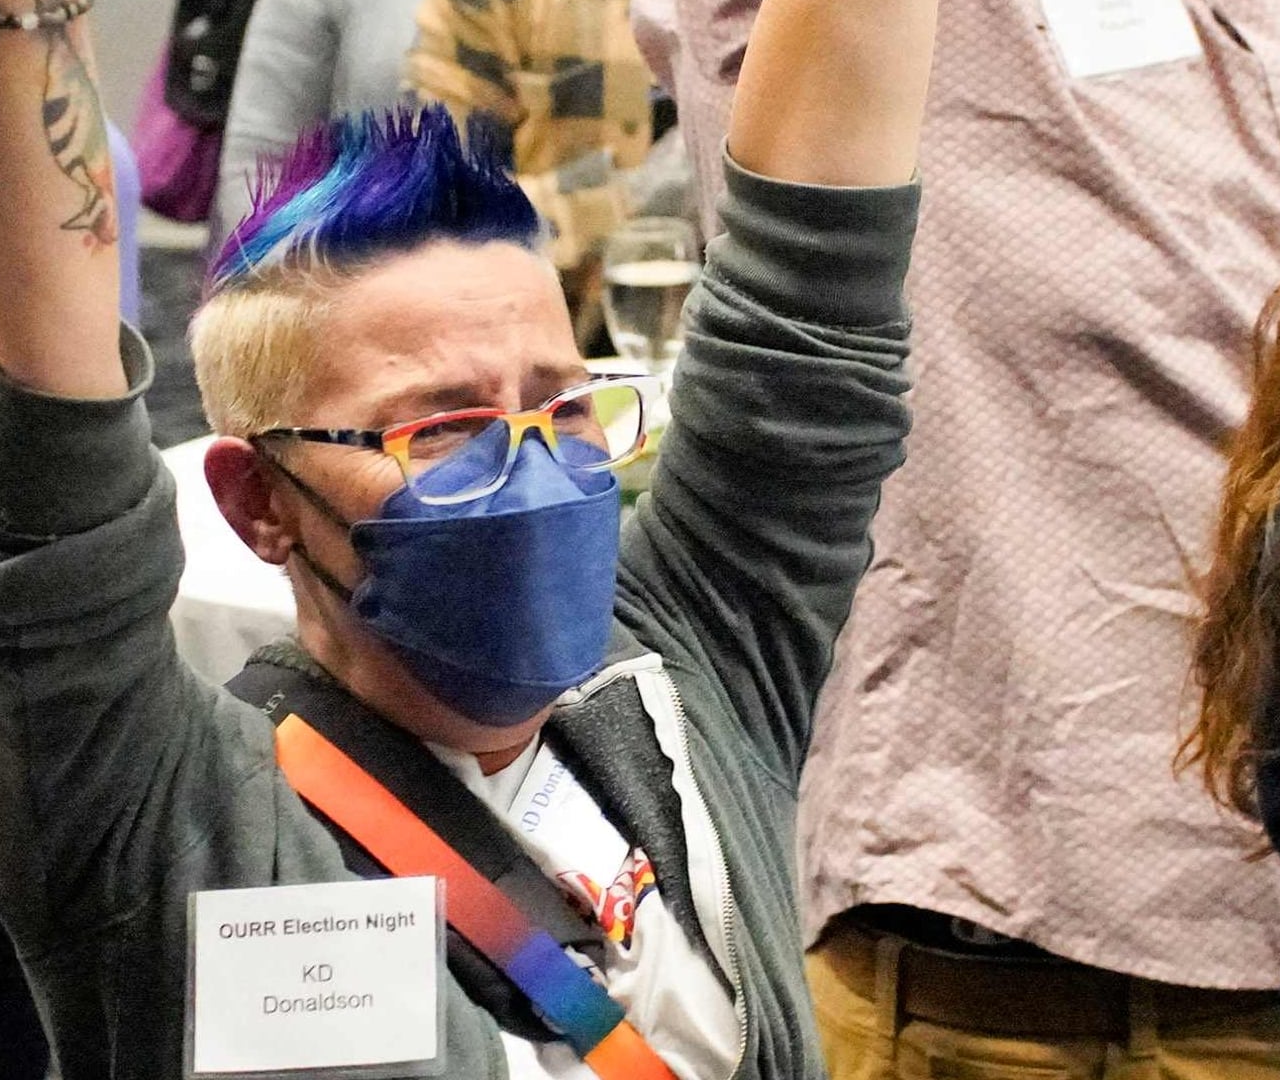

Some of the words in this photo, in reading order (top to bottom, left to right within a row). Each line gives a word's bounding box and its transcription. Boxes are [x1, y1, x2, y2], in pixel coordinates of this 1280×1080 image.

[218, 921, 277, 940] OURR
[282, 916, 359, 936] Election
[365, 910, 416, 933] Night
[301, 963, 334, 984] KD
[262, 991, 374, 1015] Donaldson
